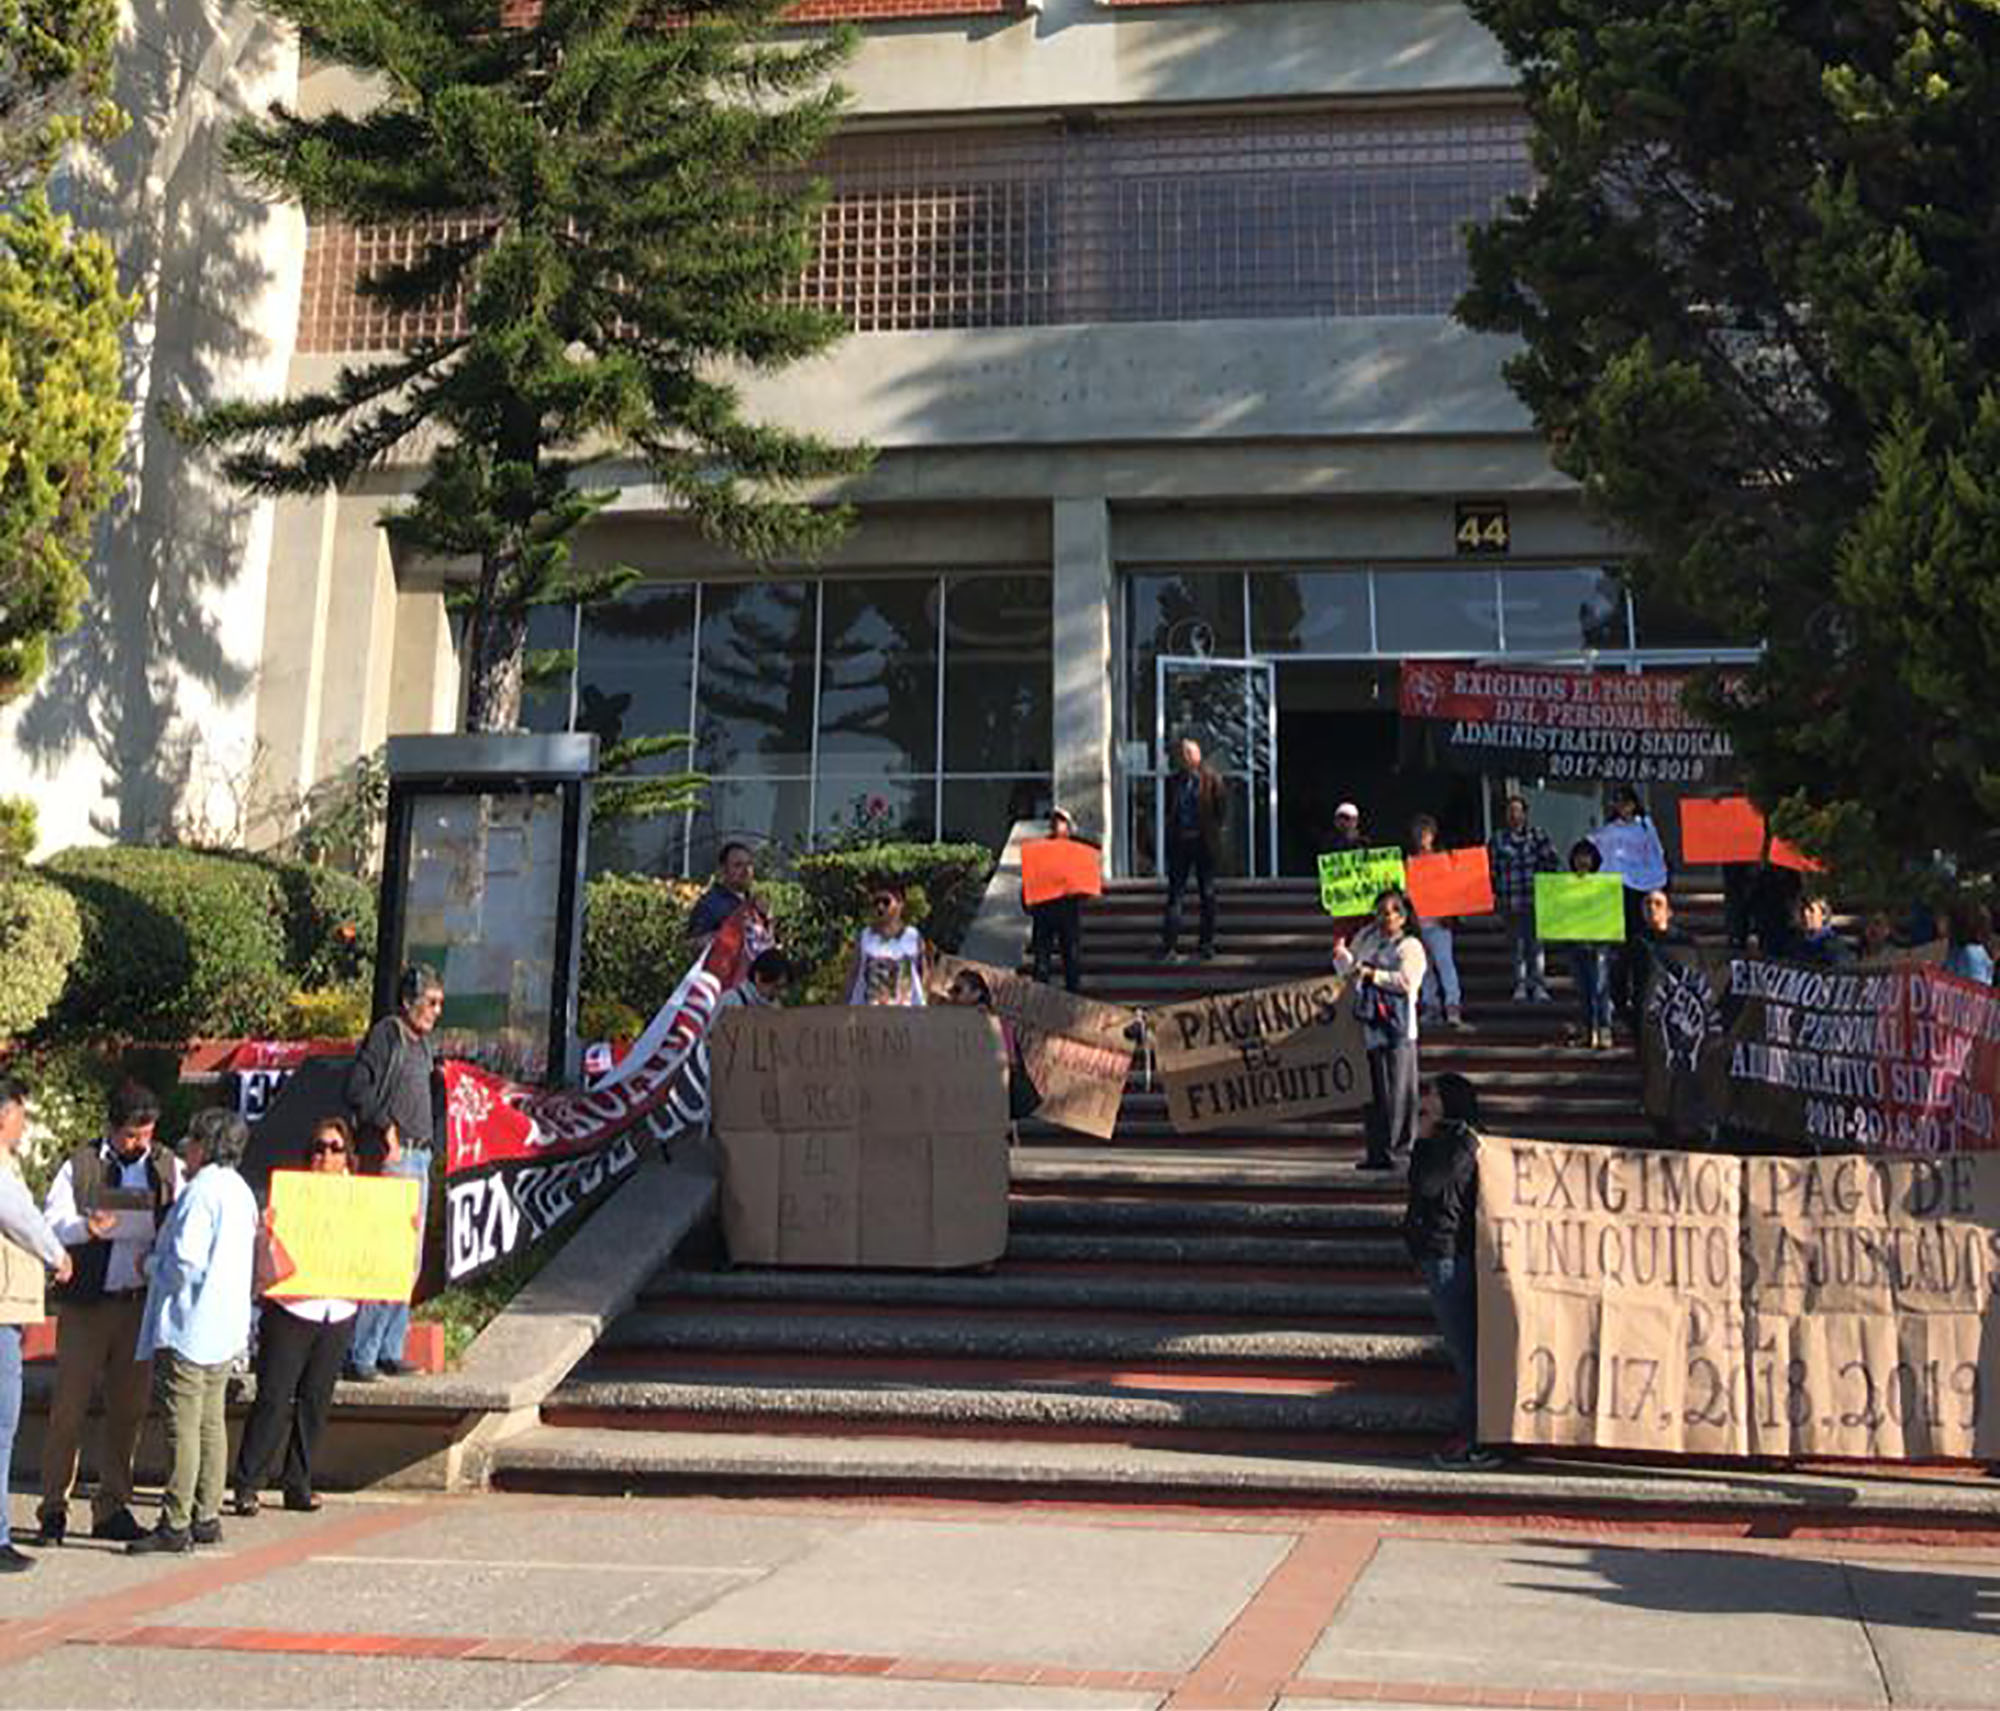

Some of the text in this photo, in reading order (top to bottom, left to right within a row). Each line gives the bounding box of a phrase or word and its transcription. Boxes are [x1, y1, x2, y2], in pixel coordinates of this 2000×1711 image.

[1458, 515, 1507, 546] 44
[1455, 671, 1565, 699] EXIGIMOS
[1573, 679, 1600, 703] EL
[1450, 722, 1636, 754] ADMINISTRATIVO
[1496, 700, 1541, 724] DEL
[1546, 703, 1656, 730] PERSONAL
[1731, 960, 1836, 1010] EGIMOS
[1242, 1039, 1281, 1072] EL
[1796, 1012, 1905, 1058] PERSONAL
[1187, 1056, 1354, 1119] FINIQUITO
[1730, 1041, 1884, 1101] ASTRATIVO
[1513, 1147, 1976, 1226] EXIGIMOS PAGO DE
[449, 1171, 519, 1278] EN
[1688, 1301, 1777, 1352] DEL
